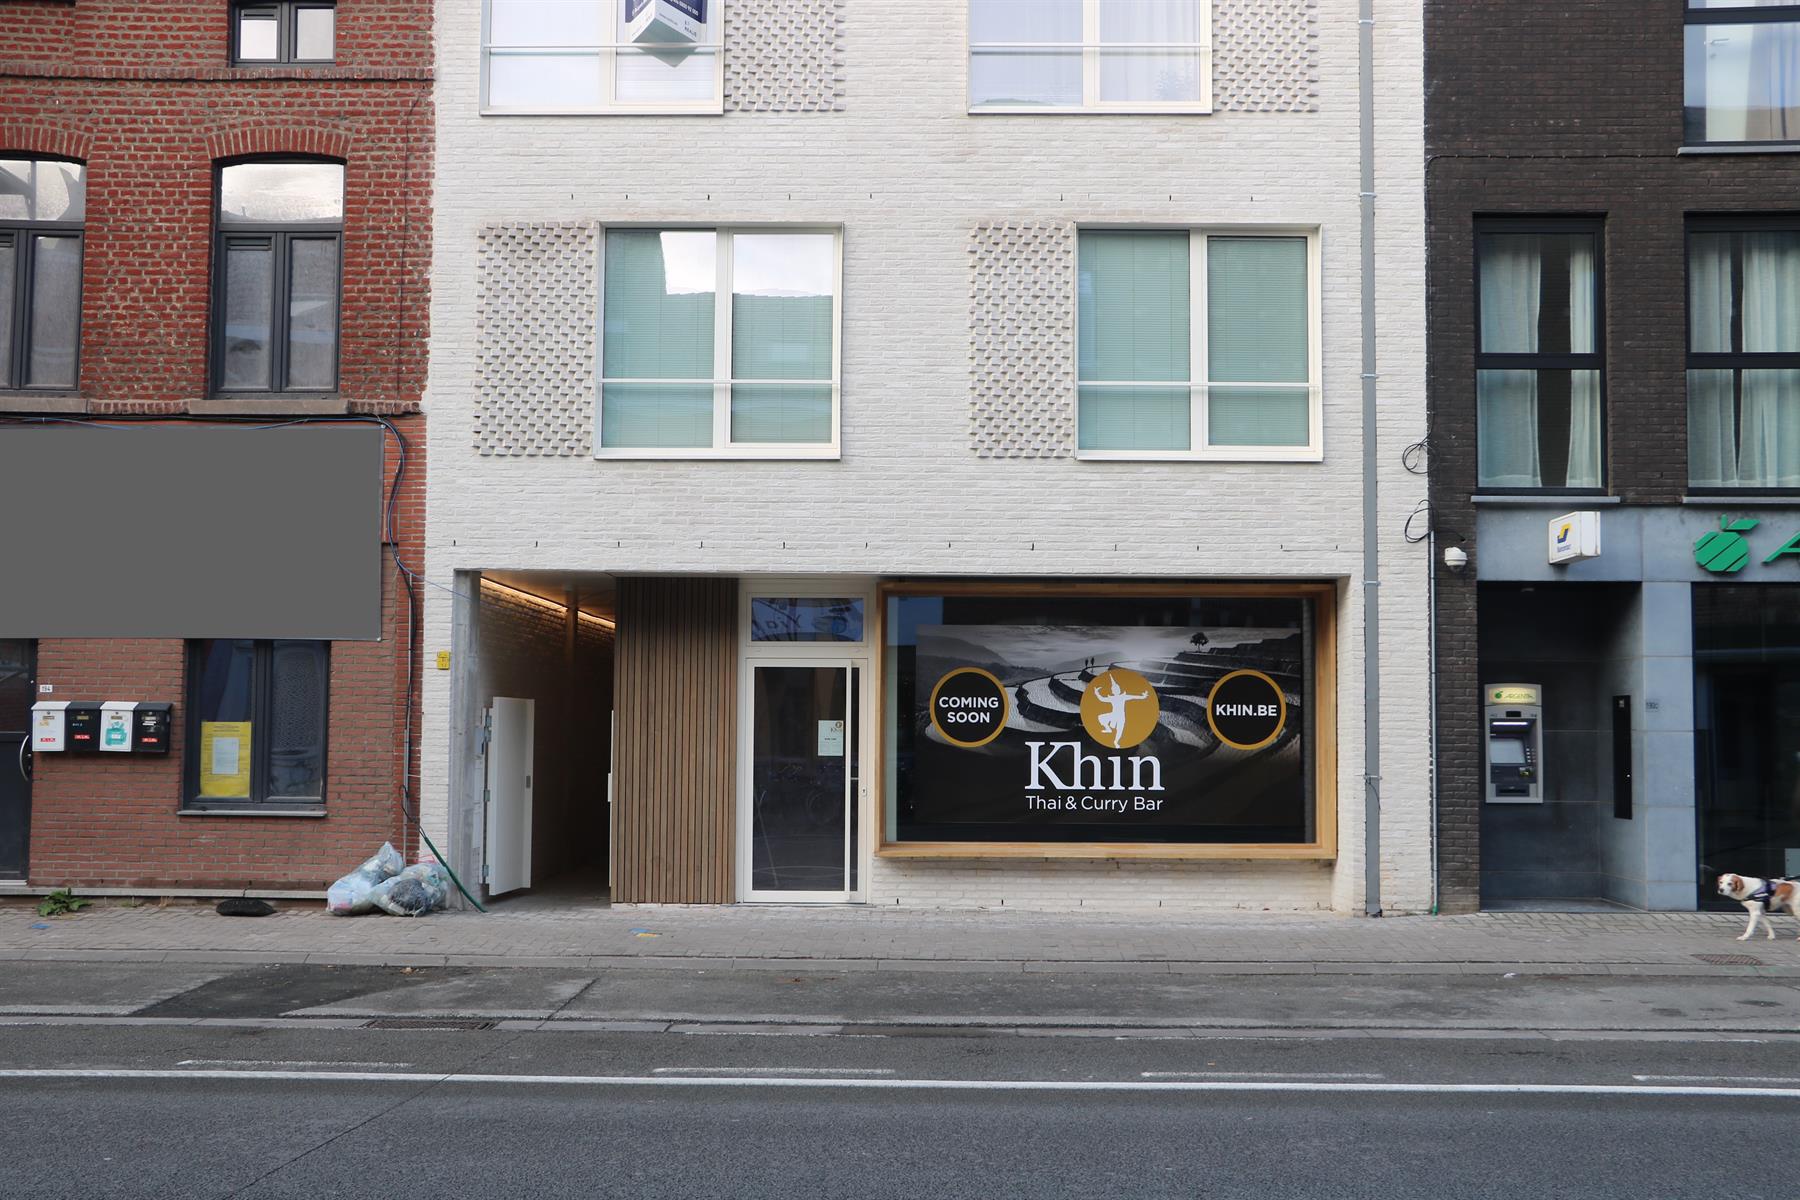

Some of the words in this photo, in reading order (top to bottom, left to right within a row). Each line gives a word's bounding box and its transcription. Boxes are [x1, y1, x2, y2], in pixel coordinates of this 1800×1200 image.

[939, 697, 999, 708] COMING
[1216, 704, 1277, 717] KHIN.BE
[947, 712, 990, 723] SOON
[1025, 741, 1165, 790] Khin
[1026, 796, 1062, 810] Thai
[1065, 796, 1078, 810] &
[1081, 796, 1128, 813] Curry
[1134, 796, 1164, 811] Bar
